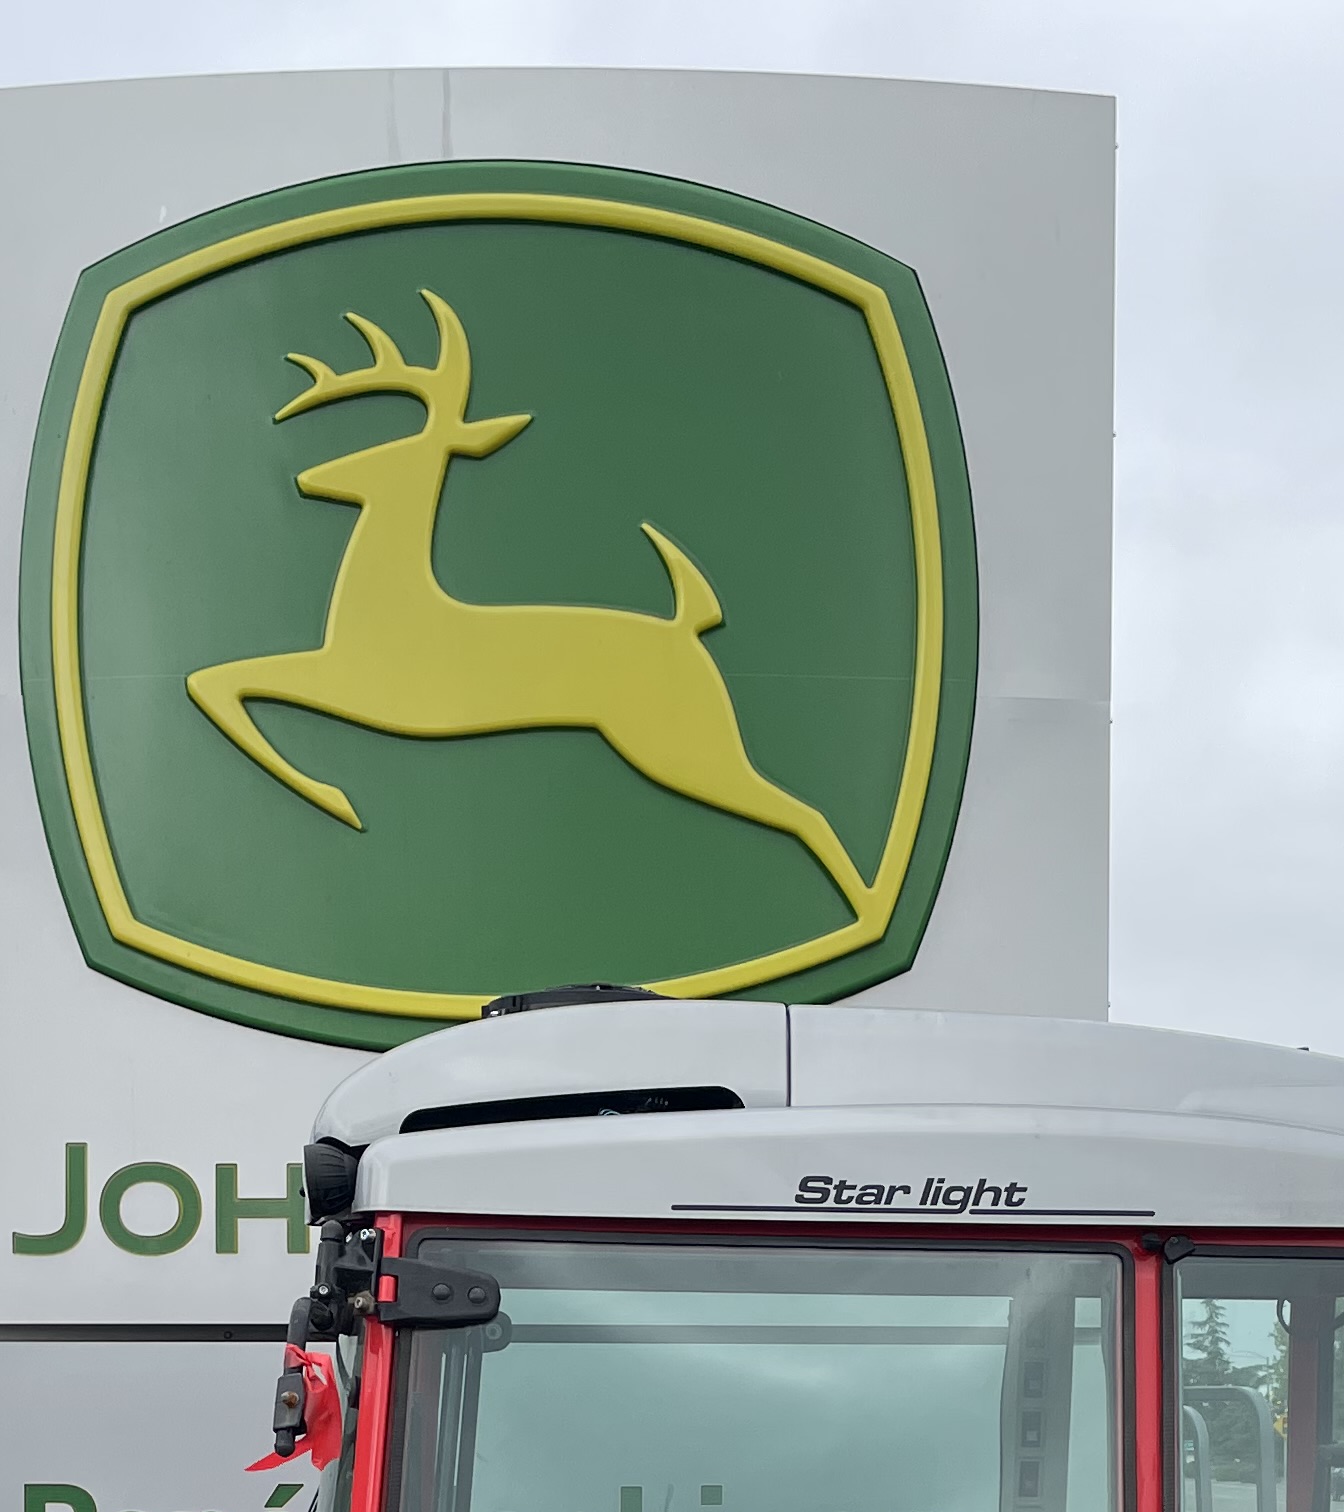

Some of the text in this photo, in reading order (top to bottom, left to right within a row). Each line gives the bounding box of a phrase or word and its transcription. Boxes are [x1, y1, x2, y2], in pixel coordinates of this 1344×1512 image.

[12, 1141, 311, 1256] JOH
[794, 1175, 1028, 1214] Star light
